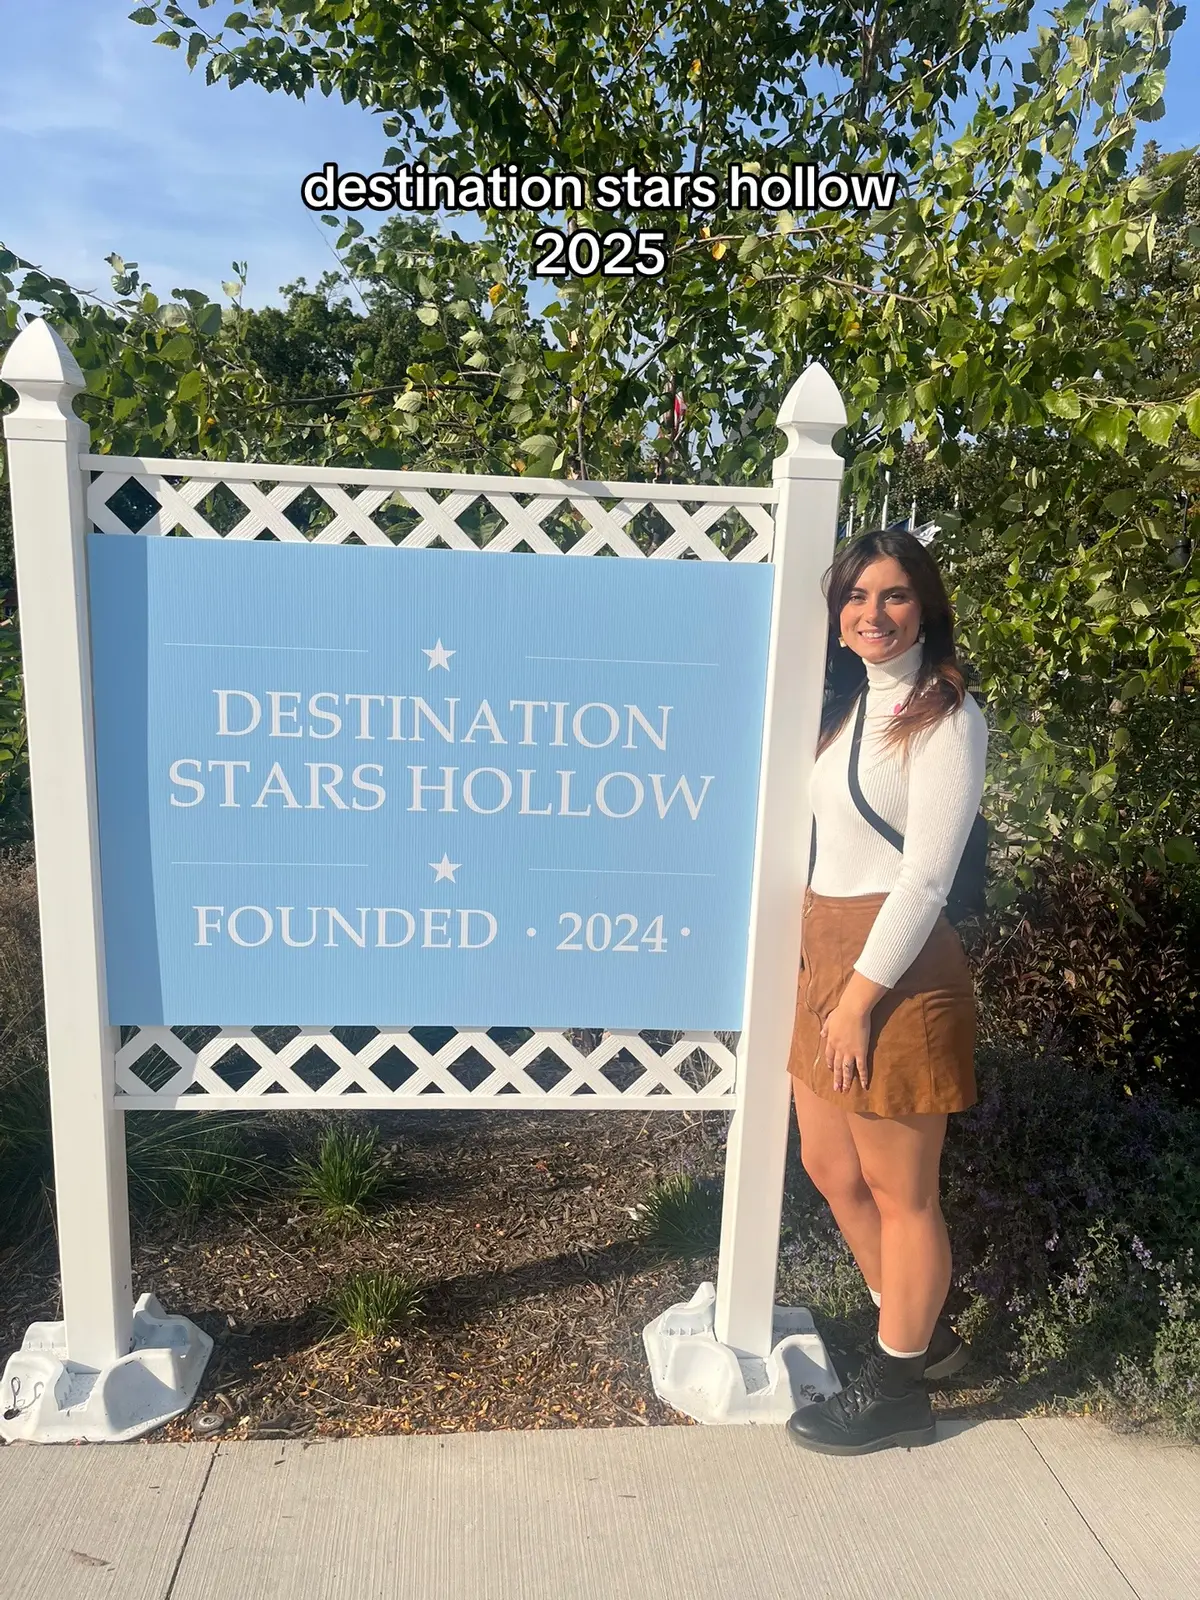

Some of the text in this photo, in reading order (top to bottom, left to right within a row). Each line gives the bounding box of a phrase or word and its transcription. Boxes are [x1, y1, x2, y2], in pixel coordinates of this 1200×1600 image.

[213, 688, 674, 751] DESTINATION
[169, 758, 716, 821] STARS HOLLOW
[192, 904, 670, 955] FOUNDED 2024
